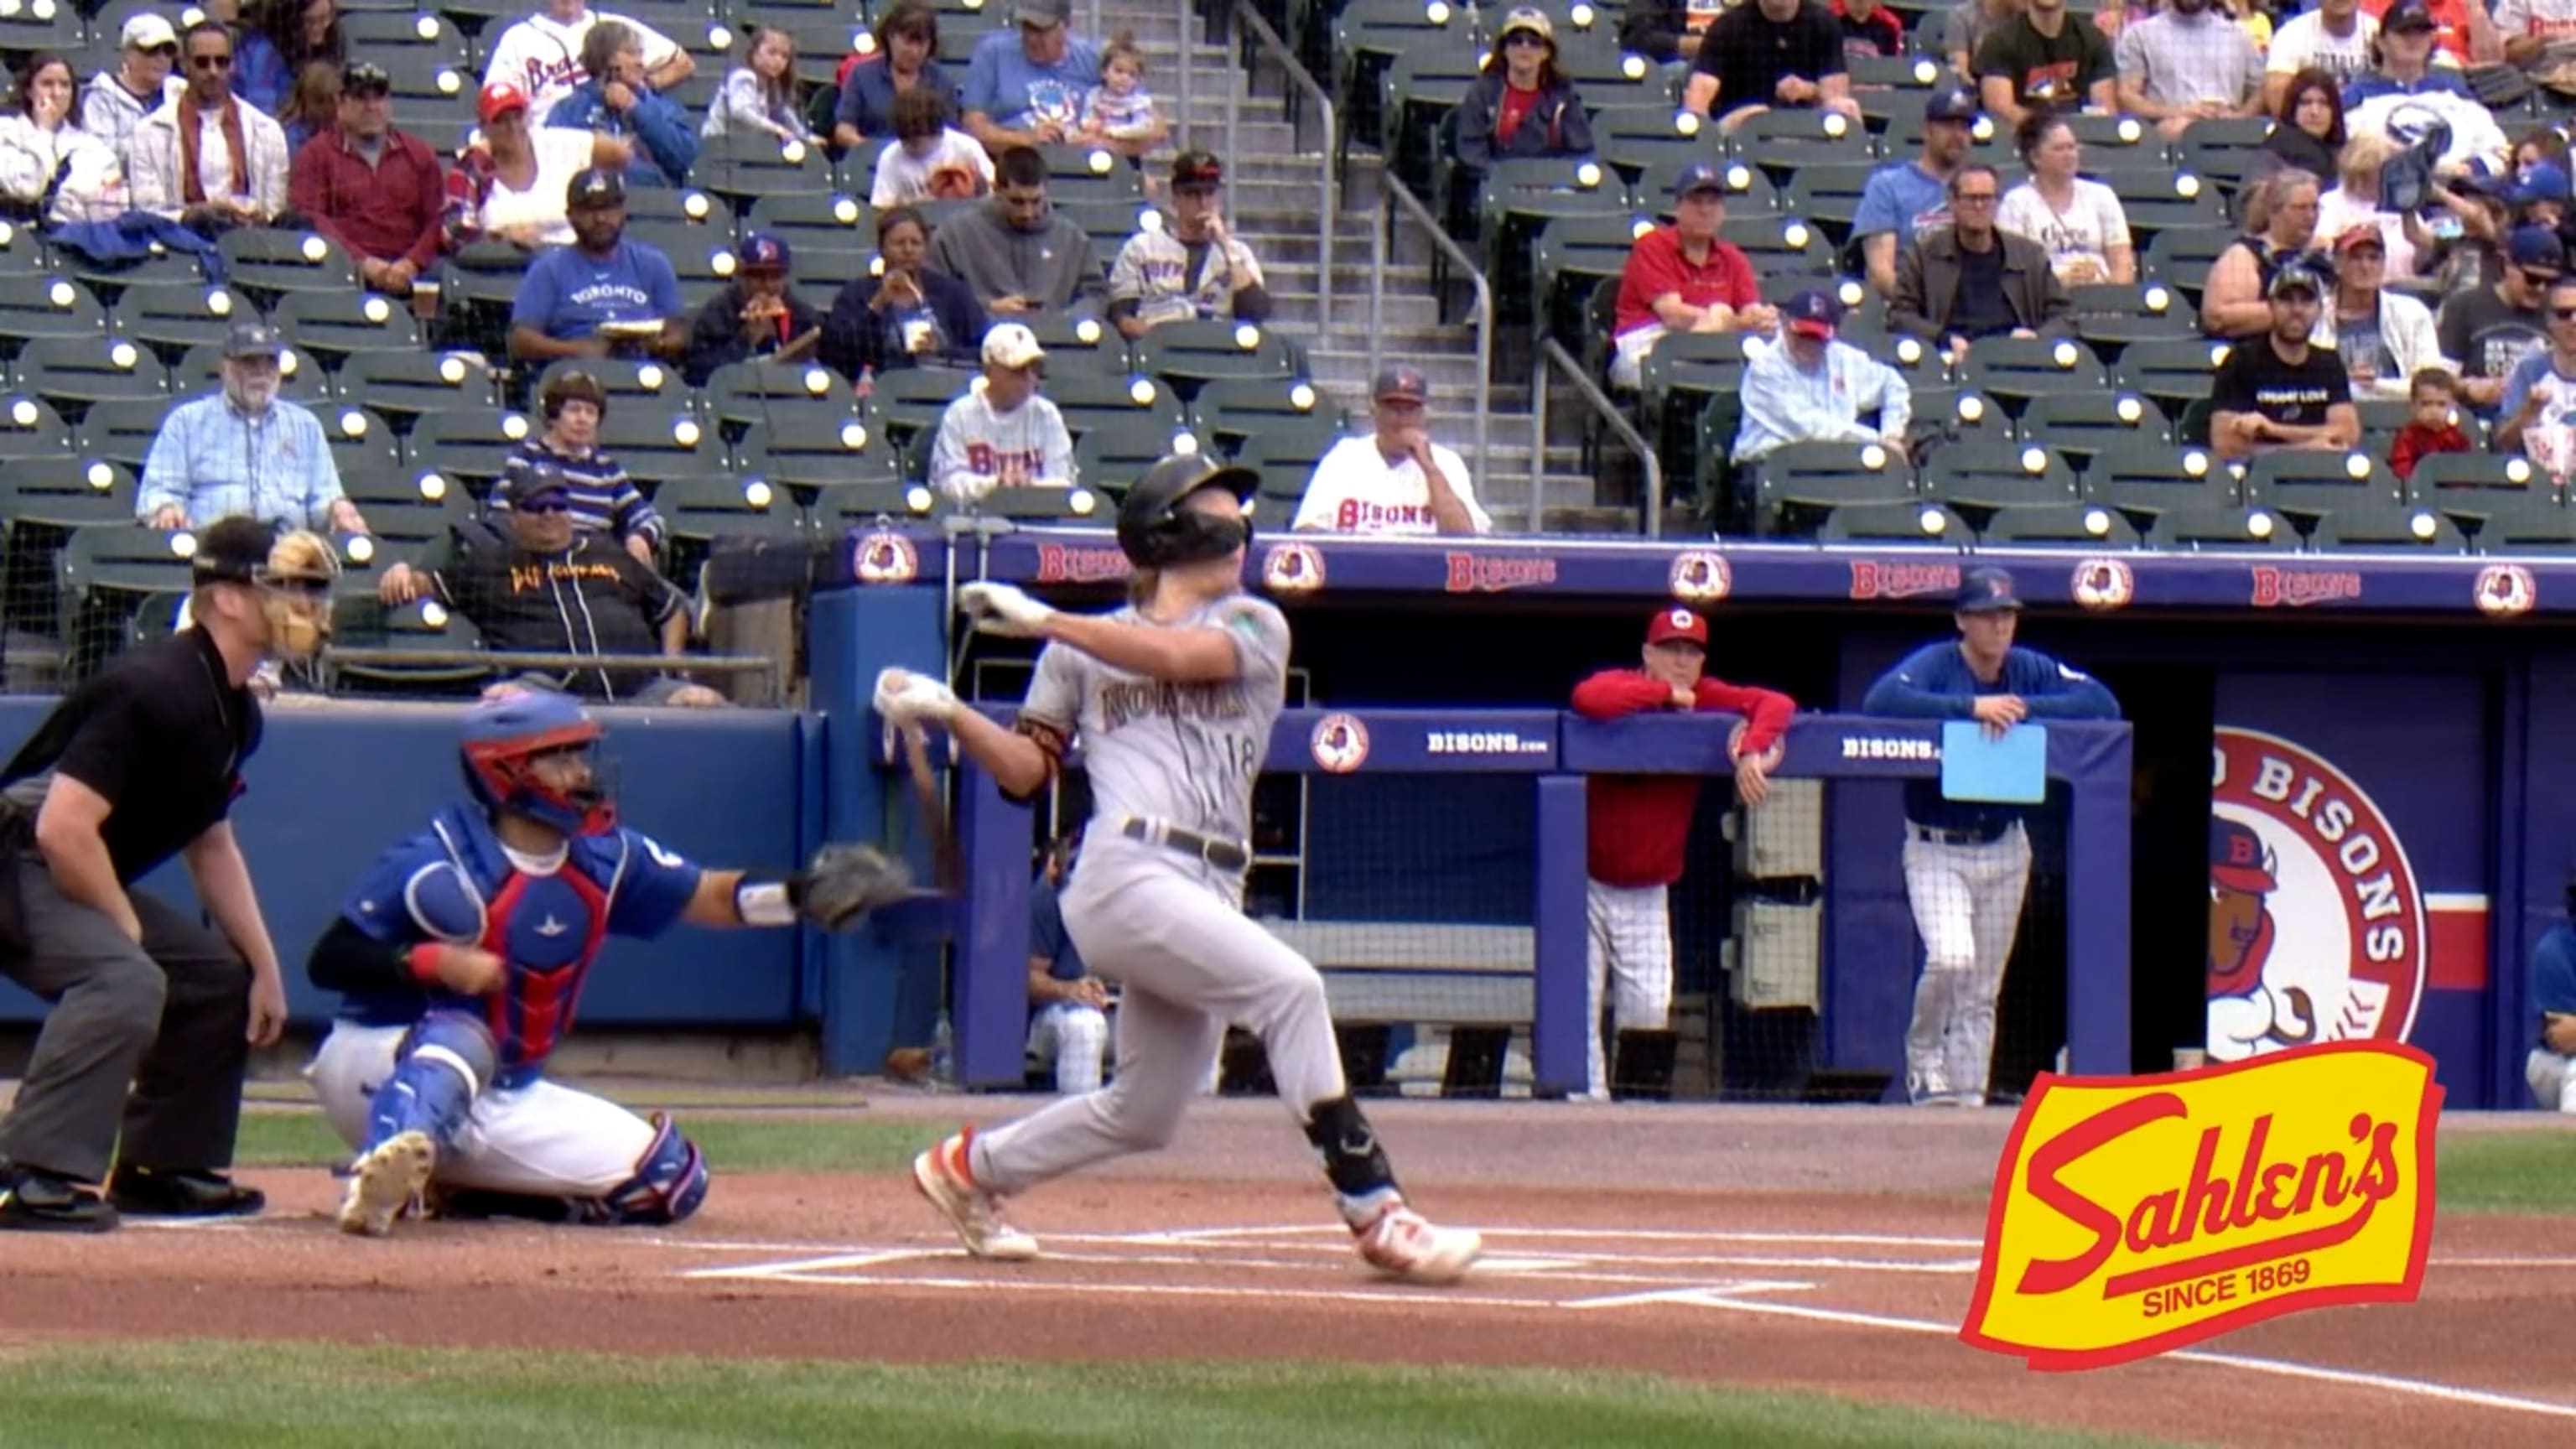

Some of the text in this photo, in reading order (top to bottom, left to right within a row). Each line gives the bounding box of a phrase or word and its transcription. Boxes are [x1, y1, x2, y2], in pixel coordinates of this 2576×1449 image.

[570, 283, 647, 304] TORONTO
[1445, 551, 1556, 592] BISONS
[1850, 560, 1961, 599] BISONS
[2251, 566, 2361, 605] BISONS
[2252, 756, 2405, 962] BISONS
